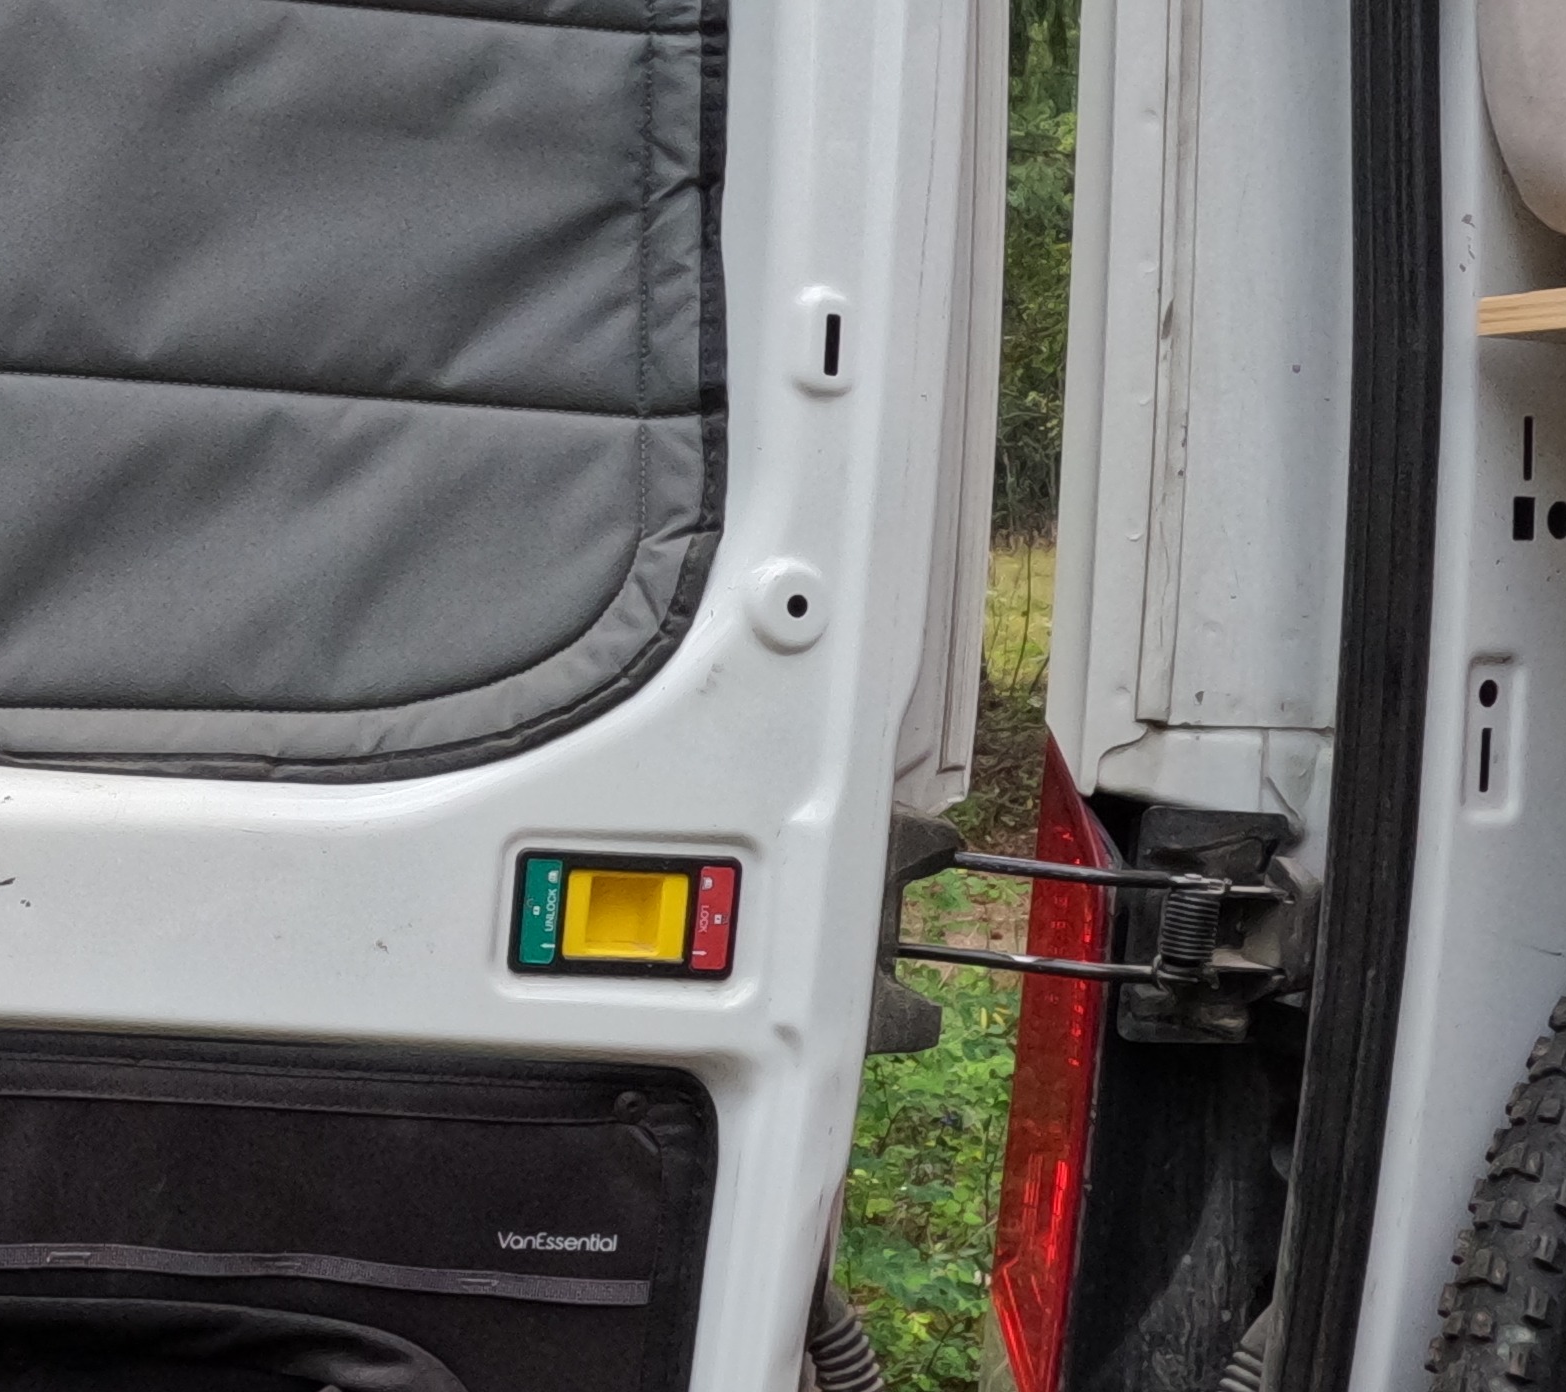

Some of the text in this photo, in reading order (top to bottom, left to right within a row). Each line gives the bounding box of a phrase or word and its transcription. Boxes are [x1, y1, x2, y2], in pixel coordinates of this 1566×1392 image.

[544, 887, 558, 933] UNLOCK
[698, 904, 710, 934] LOCK
[497, 1231, 619, 1253] VanEssential
